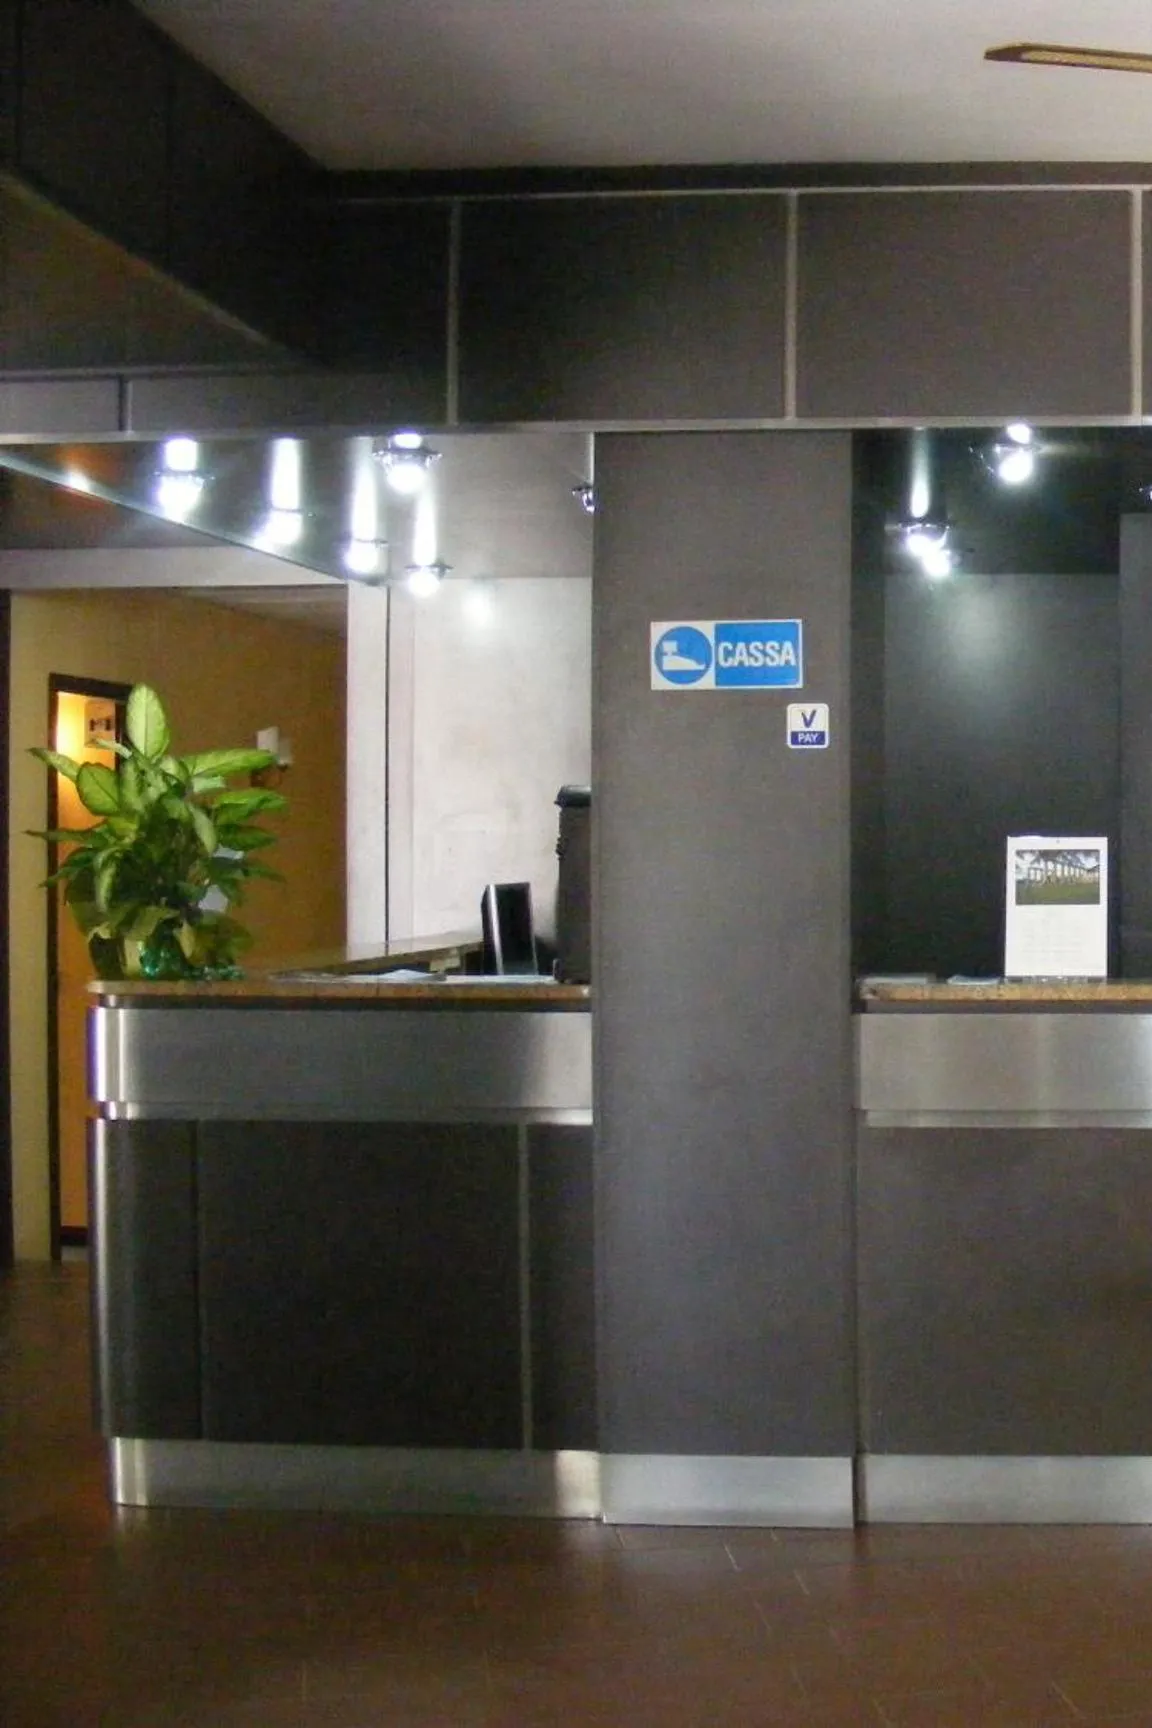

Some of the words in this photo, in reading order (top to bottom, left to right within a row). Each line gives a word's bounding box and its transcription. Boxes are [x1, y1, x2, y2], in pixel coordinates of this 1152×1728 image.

[718, 641, 796, 668] CASSA
[801, 709, 816, 728] V
[797, 733, 819, 744] PAY
